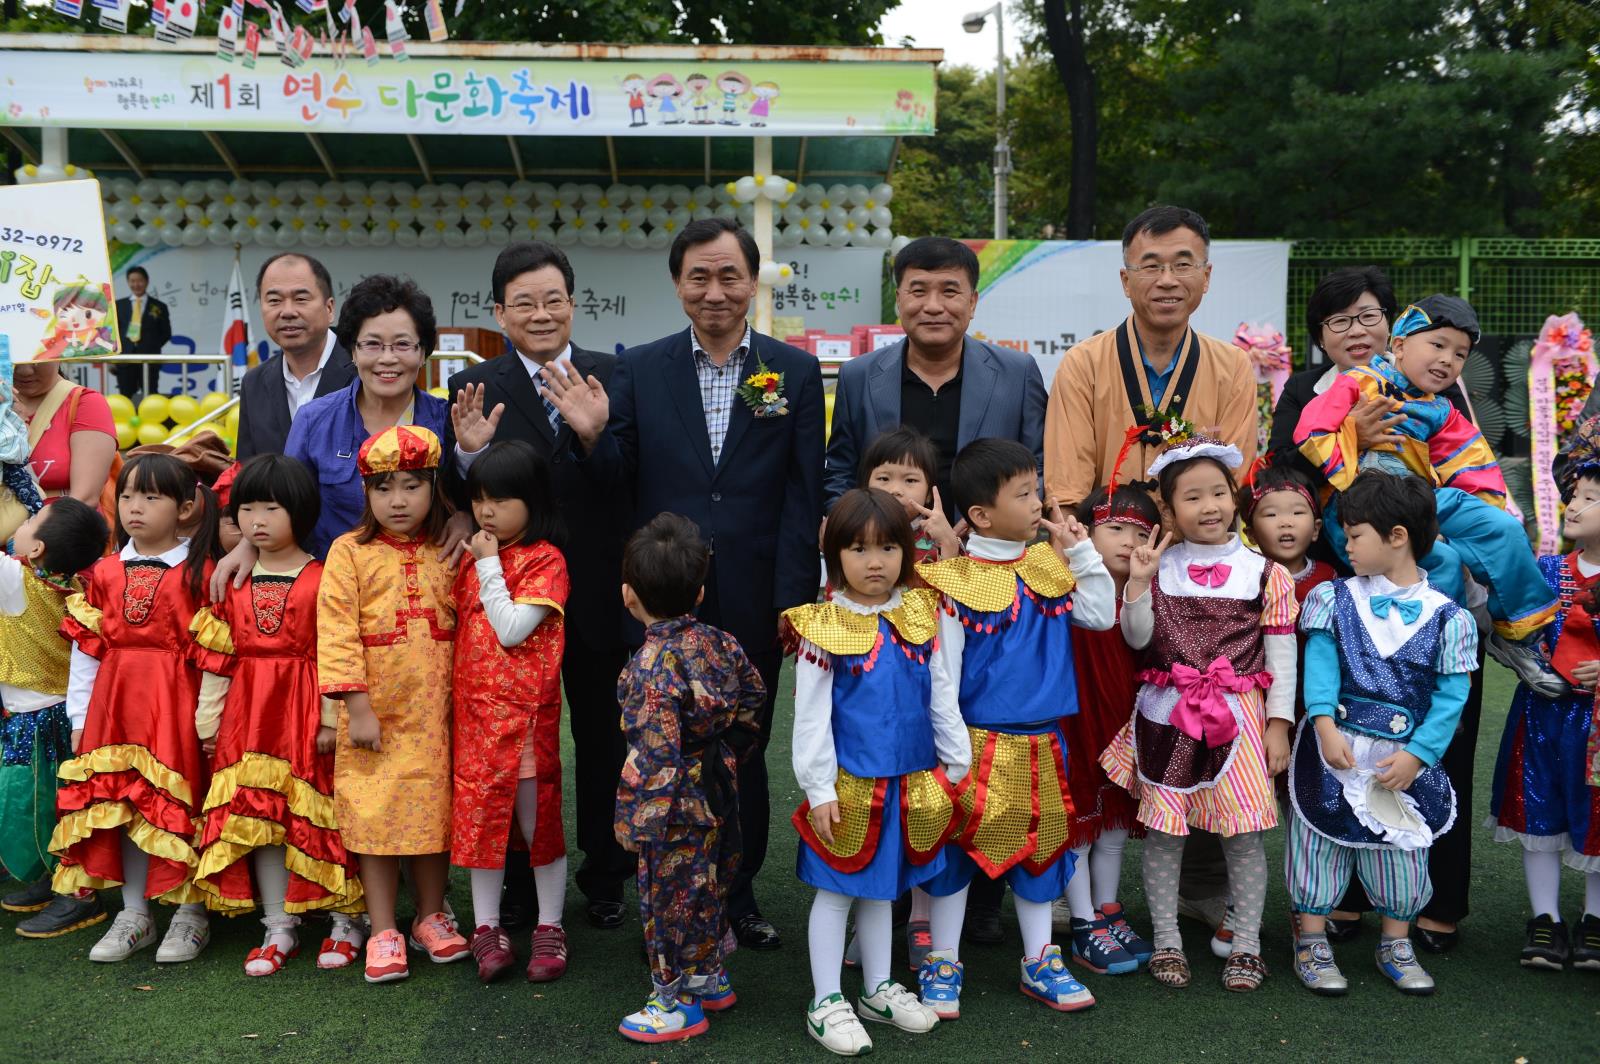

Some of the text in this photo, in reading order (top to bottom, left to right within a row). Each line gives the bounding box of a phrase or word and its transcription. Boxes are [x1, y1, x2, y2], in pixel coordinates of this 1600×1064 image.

[190, 73, 260, 110] 제1회
[283, 71, 363, 121] 연수
[1, 227, 83, 253] 32-0972
[820, 287, 860, 310] 연수!
